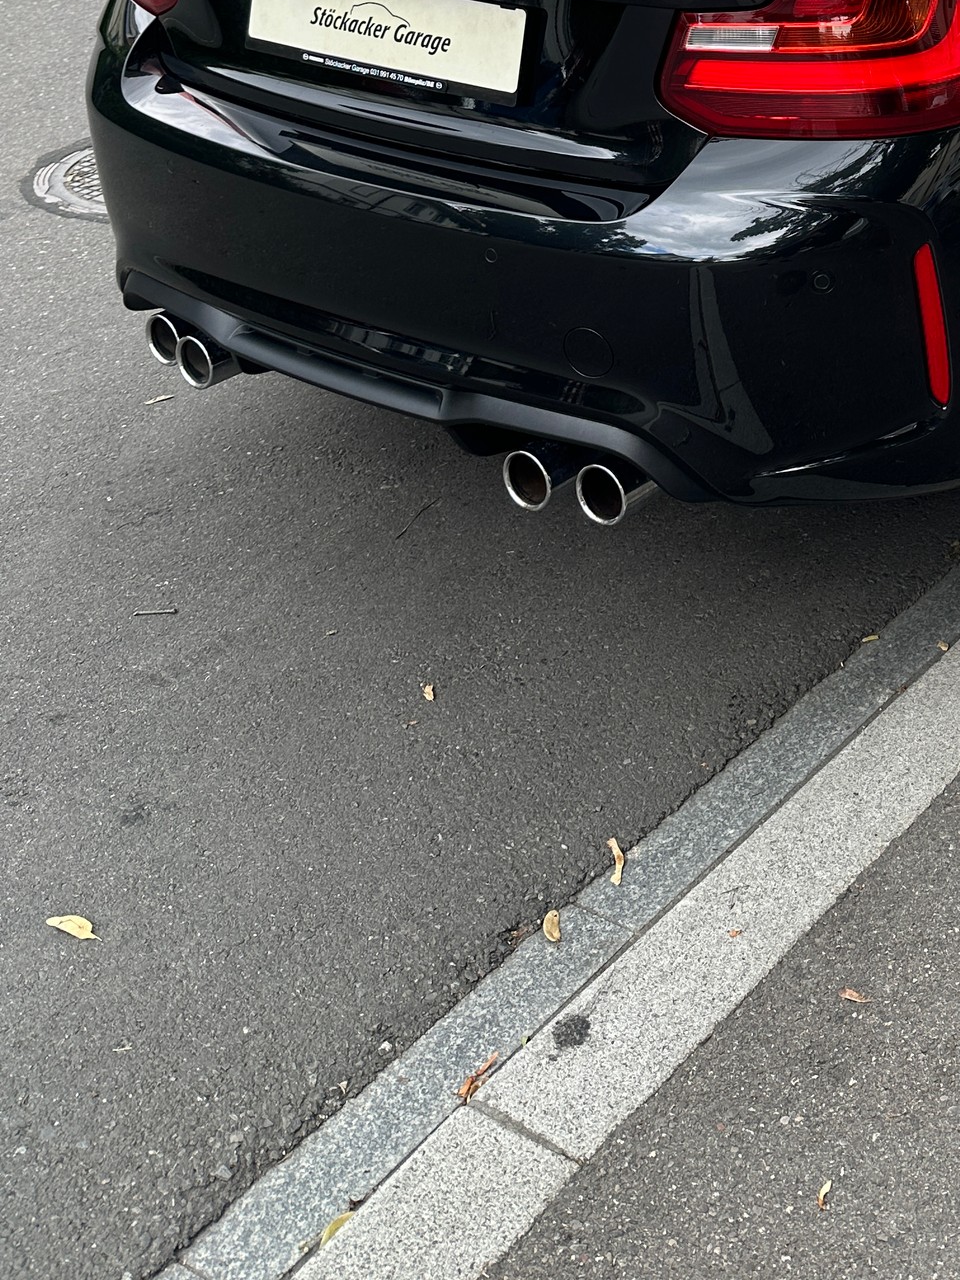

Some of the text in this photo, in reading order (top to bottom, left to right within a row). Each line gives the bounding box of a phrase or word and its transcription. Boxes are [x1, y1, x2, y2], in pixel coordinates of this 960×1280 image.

[310, 6, 451, 56] Stöckacker Garage
[324, 58, 352, 70] Stöckacker
[351, 64, 370, 74] Garage
[370, 68, 379, 76] 031
[379, 70, 389, 78] 991
[389, 72, 397, 80] 45
[396, 73, 404, 81] 70
